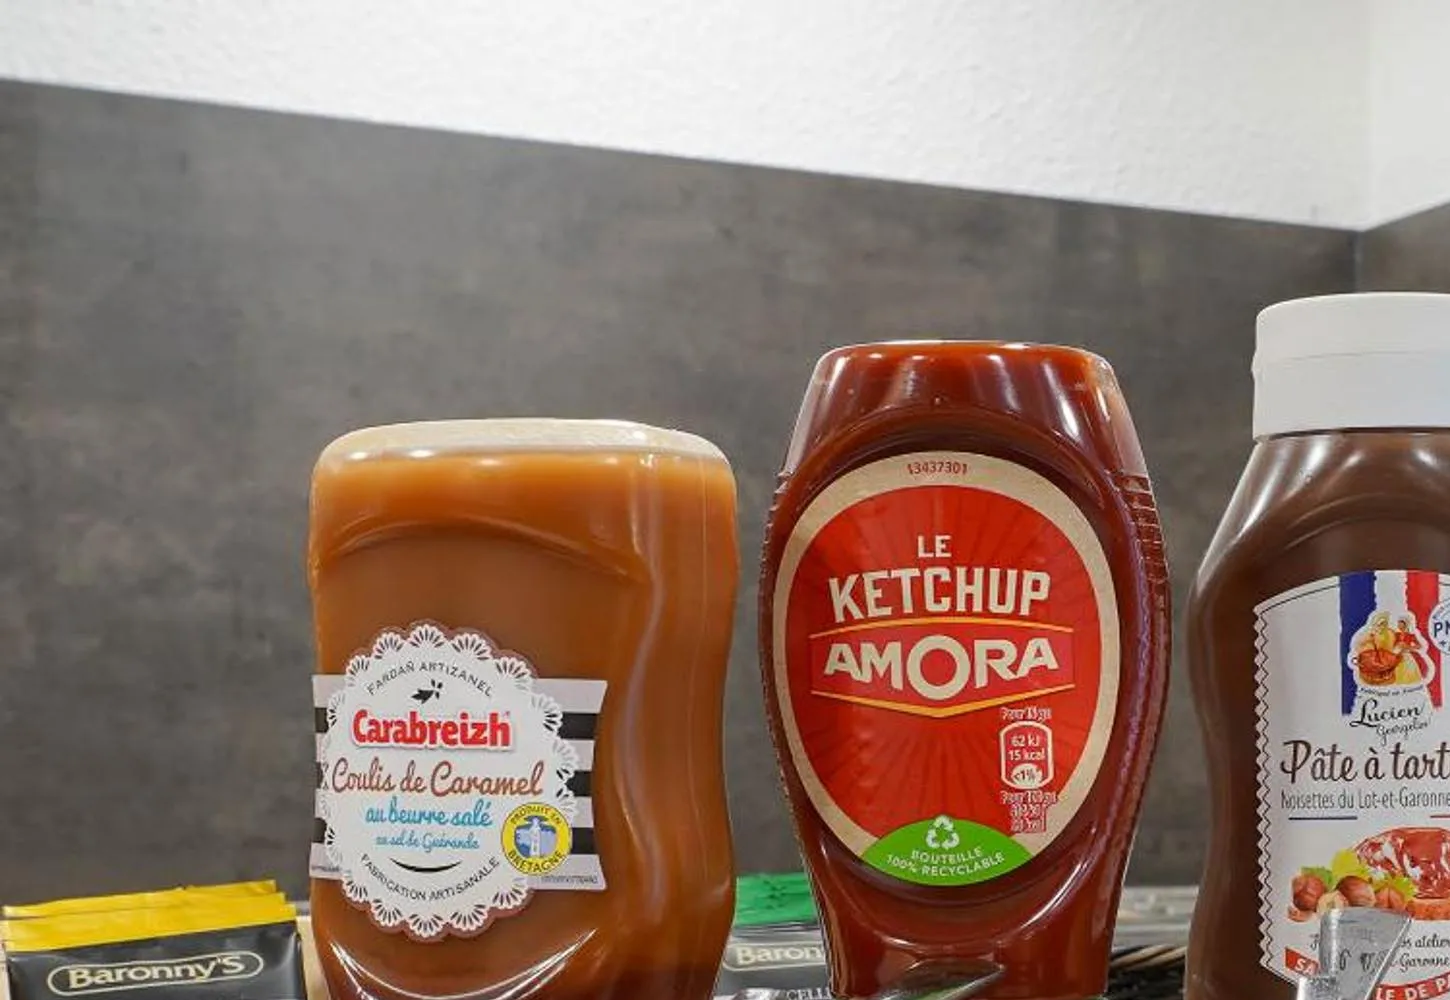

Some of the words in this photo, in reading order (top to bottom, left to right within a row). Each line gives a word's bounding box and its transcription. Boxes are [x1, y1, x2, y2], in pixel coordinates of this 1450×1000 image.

[906, 461, 968, 476] 13437301
[917, 535, 952, 558] LE
[828, 566, 1052, 623] KETCHUP
[824, 634, 1059, 700] AMORA
[1349, 698, 1424, 728] Lucien
[353, 709, 511, 747] Carabreizh
[1280, 739, 1358, 785] Pâte
[1364, 748, 1386, 780] à
[332, 757, 396, 793] Coulis
[400, 760, 426, 792] de
[430, 760, 544, 797] Caramel
[365, 806, 385, 823] au
[388, 797, 450, 825] beurre
[451, 799, 493, 826] salé
[1281, 789, 1335, 809] Noisettes
[1337, 788, 1355, 809] du
[507, 850, 563, 873] BRETAGNE
[886, 854, 918, 873] 100%
[921, 852, 1005, 877] RECYCLABLE
[911, 846, 983, 865] BOUTEILLE
[360, 853, 427, 901] FABRICATION
[428, 857, 500, 901] ARTISANALE
[736, 945, 825, 966] Baron
[1404, 987, 1429, 1000] DE
